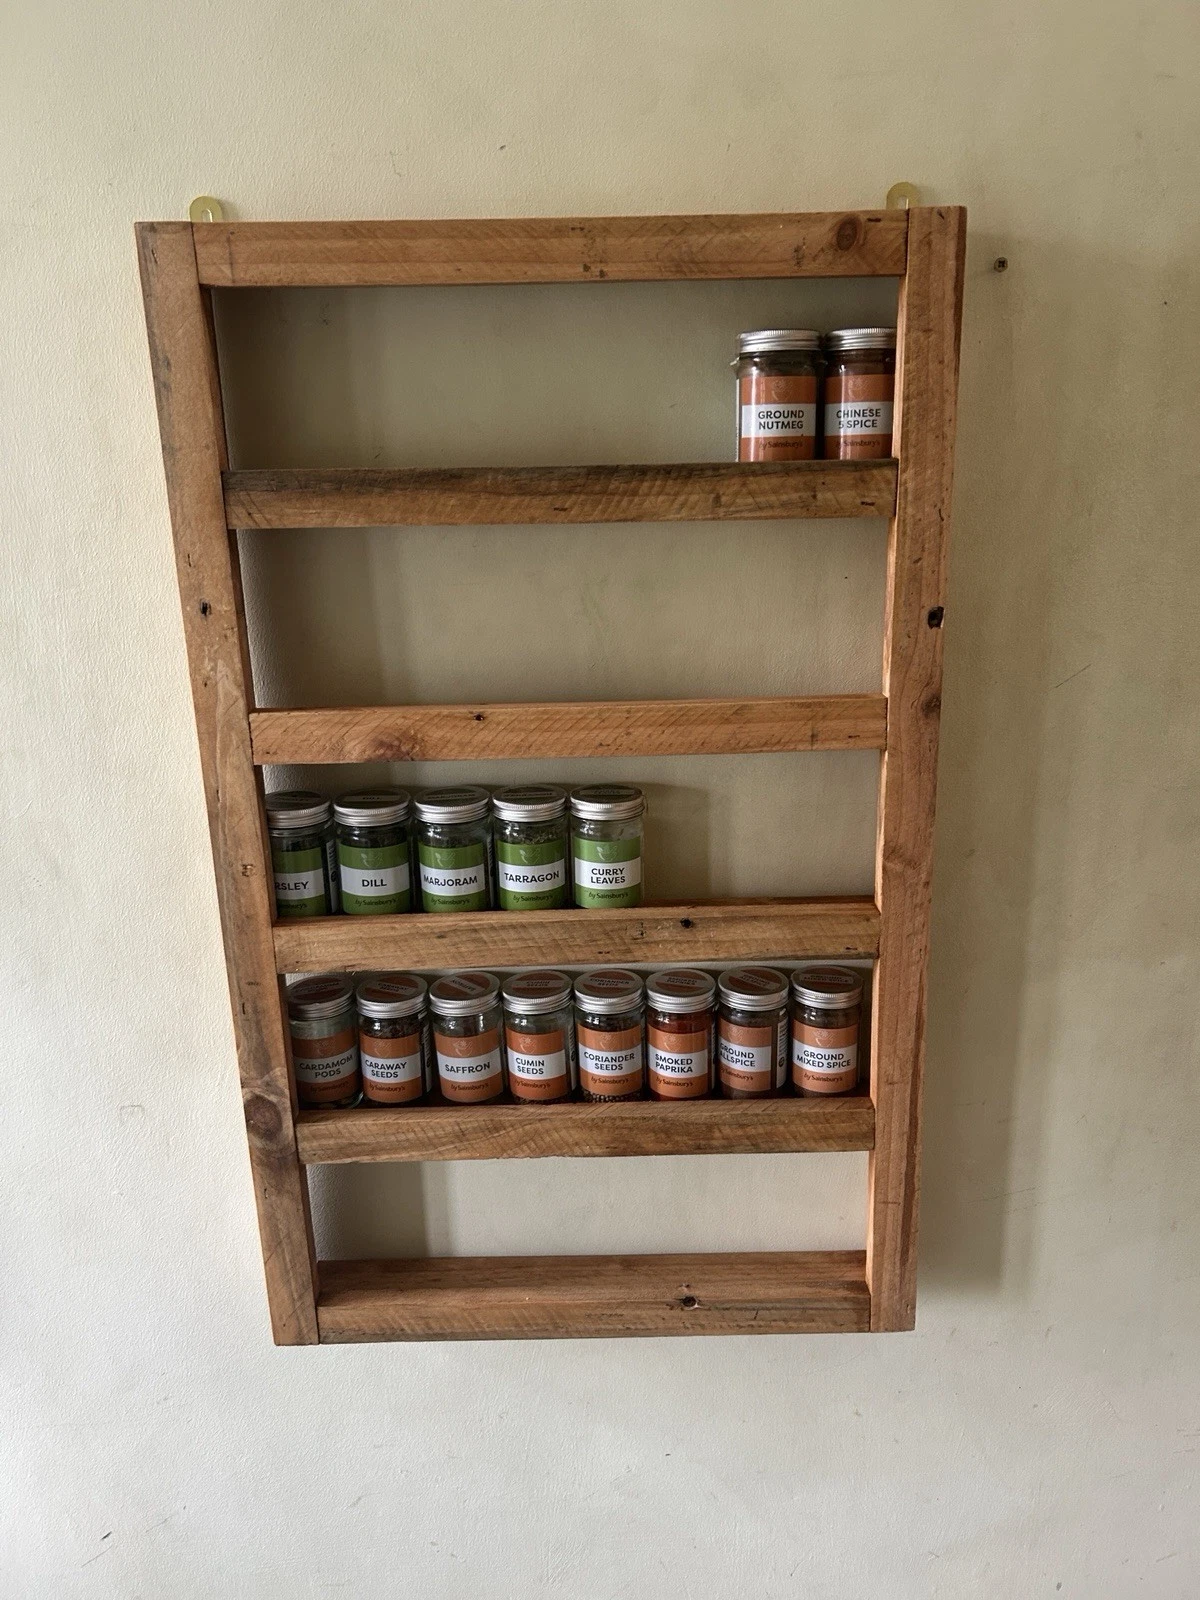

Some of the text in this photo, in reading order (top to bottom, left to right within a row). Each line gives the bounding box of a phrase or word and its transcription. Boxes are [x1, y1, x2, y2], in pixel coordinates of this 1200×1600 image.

[758, 409, 805, 420] GROUND
[836, 408, 881, 419] CHINESE
[758, 420, 804, 430] NUTMEG
[838, 419, 877, 428] 5 SPICE
[504, 870, 560, 883] TARRAGON
[591, 867, 625, 876] CURRY
[361, 878, 387, 888] DILL
[423, 874, 478, 887] MARJORAM
[590, 876, 626, 884] LEAVES
[274, 880, 309, 891] RSLEY
[513, 893, 553, 903] by Sainsbury's
[589, 891, 629, 900] by Sainsbury's
[355, 898, 397, 907] by Sainsbury's
[438, 897, 470, 905] Sainsbury's
[583, 1052, 635, 1063] CORIANDER
[655, 1053, 693, 1066] SMOKED
[803, 1050, 845, 1061] GROUND
[299, 1054, 354, 1071] CARDAMOM
[364, 1059, 407, 1070] CARAWAY
[515, 1057, 545, 1067] CUMIN
[594, 1062, 624, 1071] SEEDS
[796, 1054, 851, 1069] MIXED SPICE
[445, 1061, 491, 1074] SAFFRON
[517, 1066, 544, 1075] SEEDS
[655, 1061, 693, 1073] PAPRIKA
[315, 1067, 342, 1078] PODS
[371, 1069, 399, 1078] SEEDS
[591, 1077, 629, 1085] by Sainsbury's
[656, 1076, 693, 1087] by Sainsbury's
[803, 1073, 843, 1083] by Sainsbury's
[375, 1084, 405, 1092] Sainsbury's
[450, 1082, 489, 1091] by Sainsbury's
[520, 1081, 551, 1089] Sainsbury's
